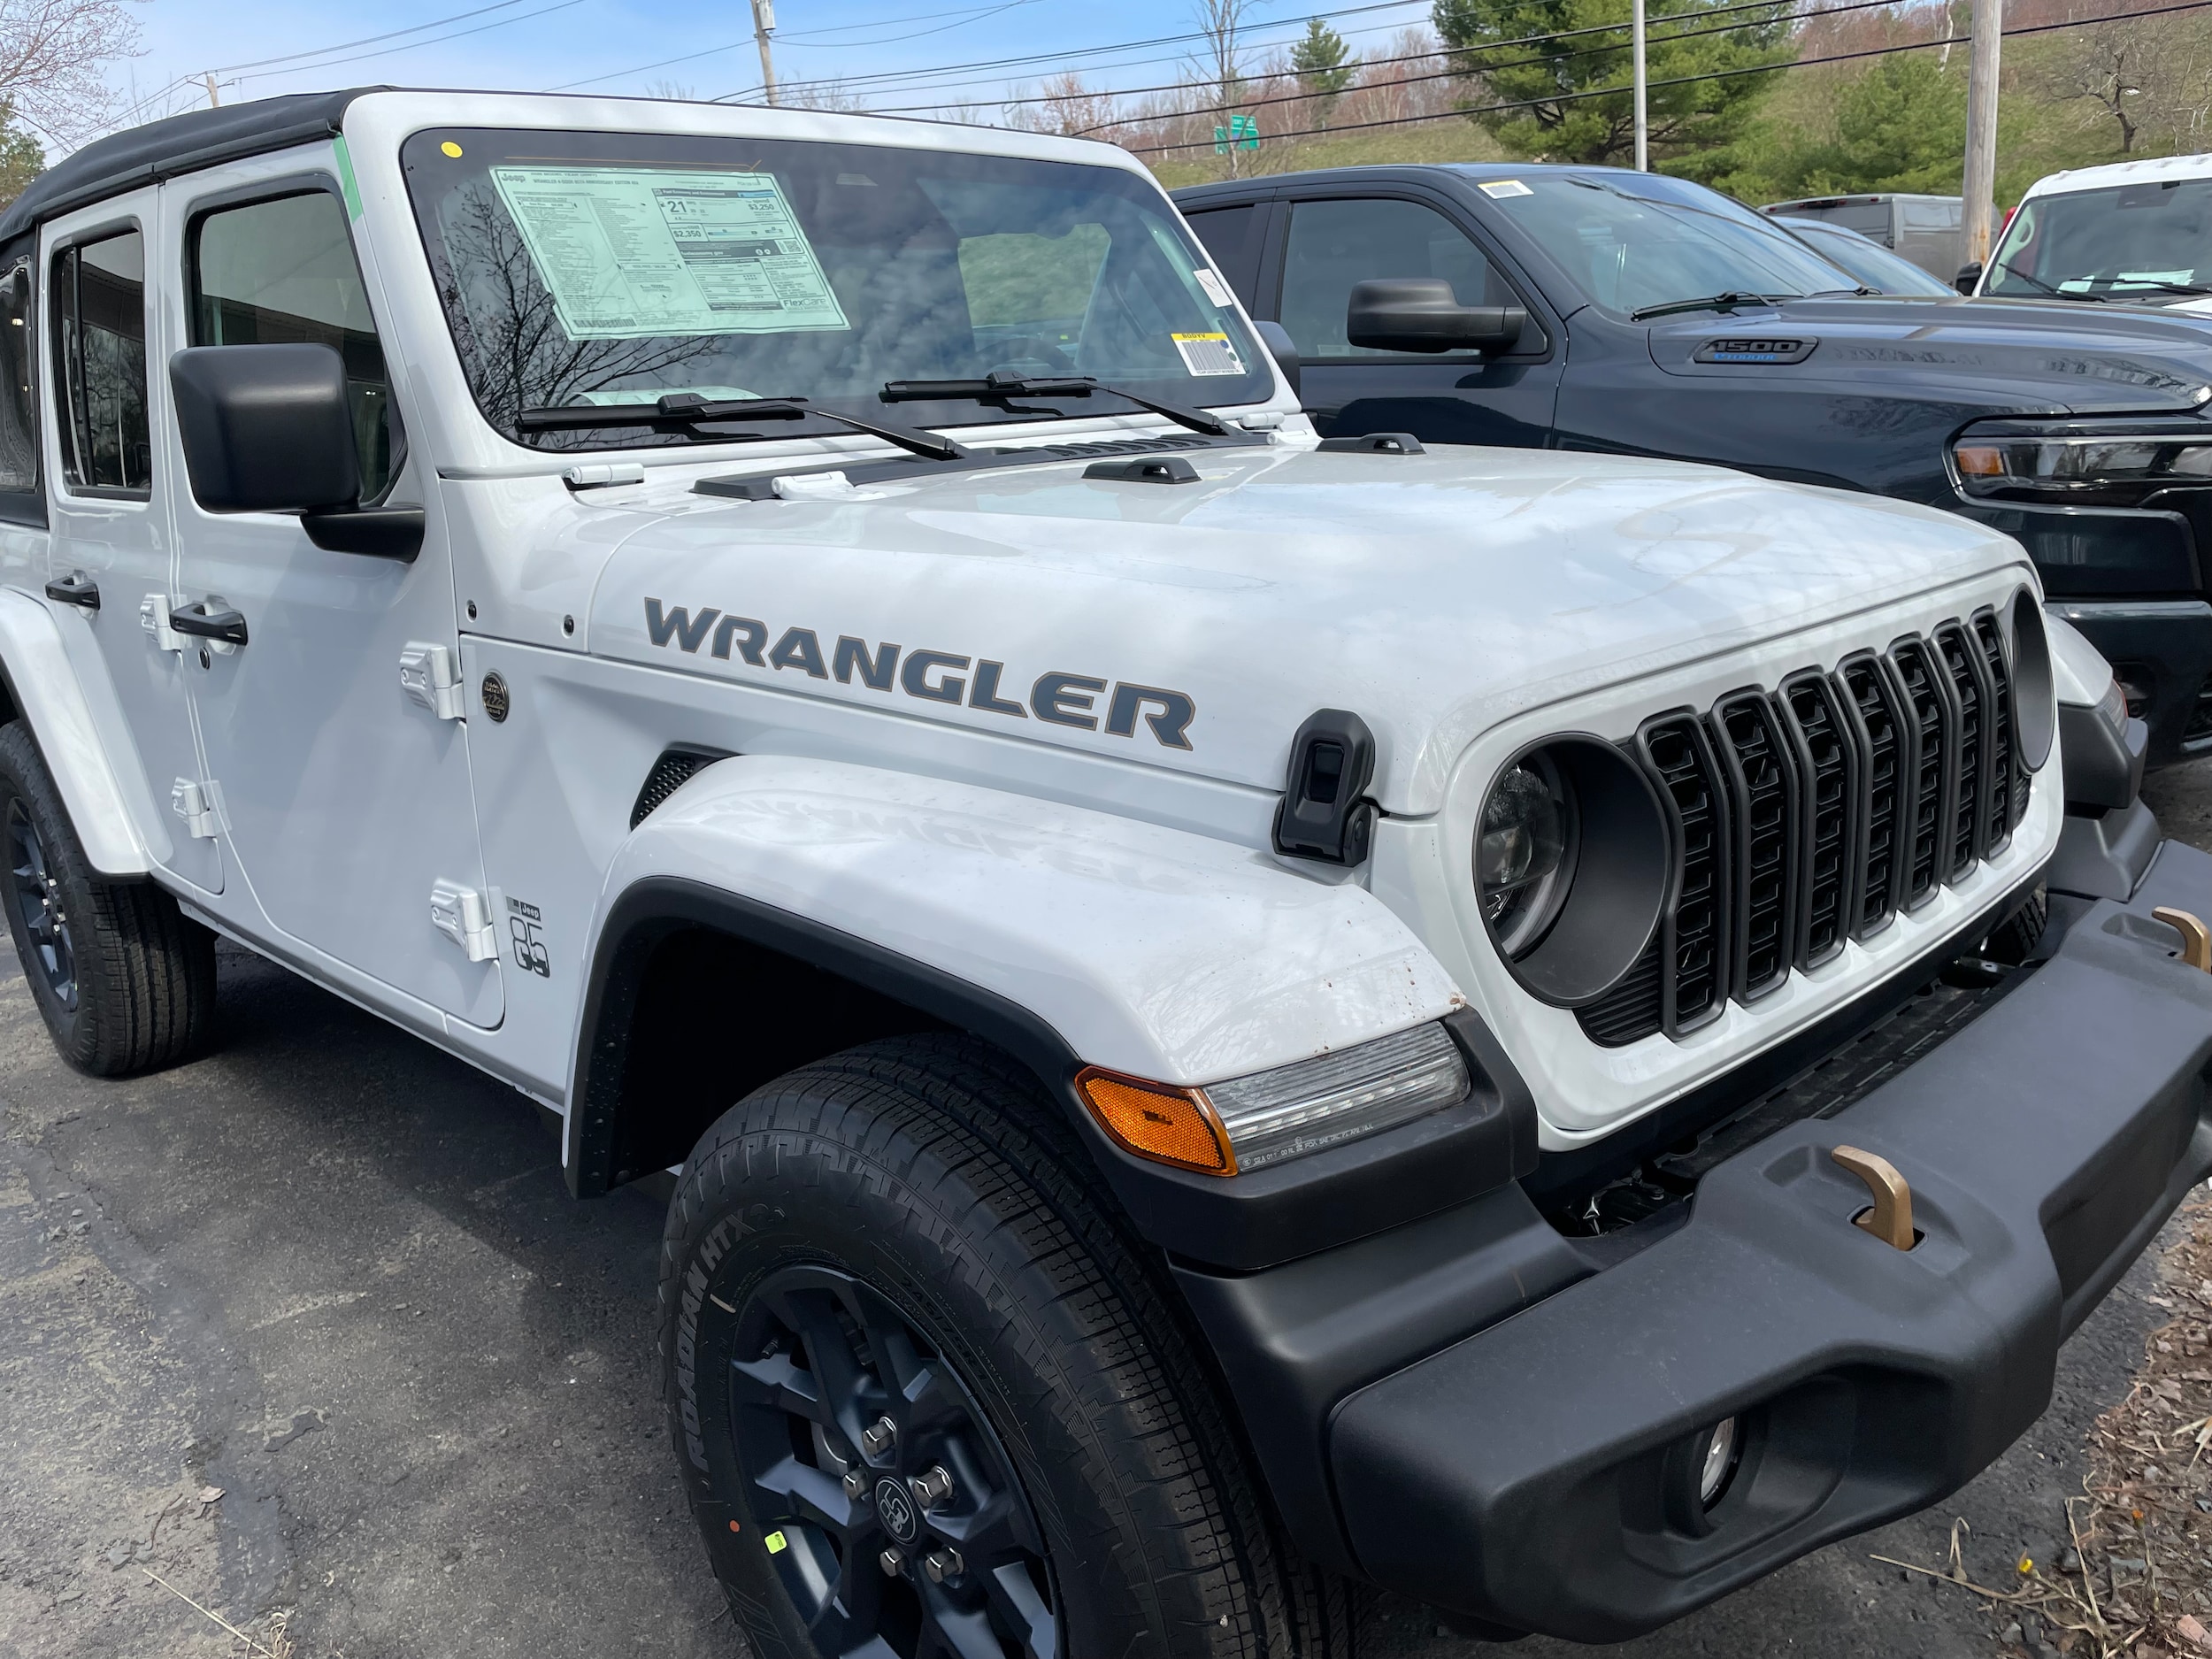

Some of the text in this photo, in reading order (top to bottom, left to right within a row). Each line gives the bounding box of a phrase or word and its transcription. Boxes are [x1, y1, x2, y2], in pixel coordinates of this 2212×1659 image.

[667, 201, 687, 213] 21
[784, 297, 826, 307] FlexCare
[1714, 341, 1798, 353] 1500
[644, 596, 1196, 751] WRANGLER
[522, 903, 540, 919] Jeep
[510, 915, 550, 979] 85
[676, 1259, 710, 1472] ROADIAN
[699, 1208, 753, 1272] HTX
